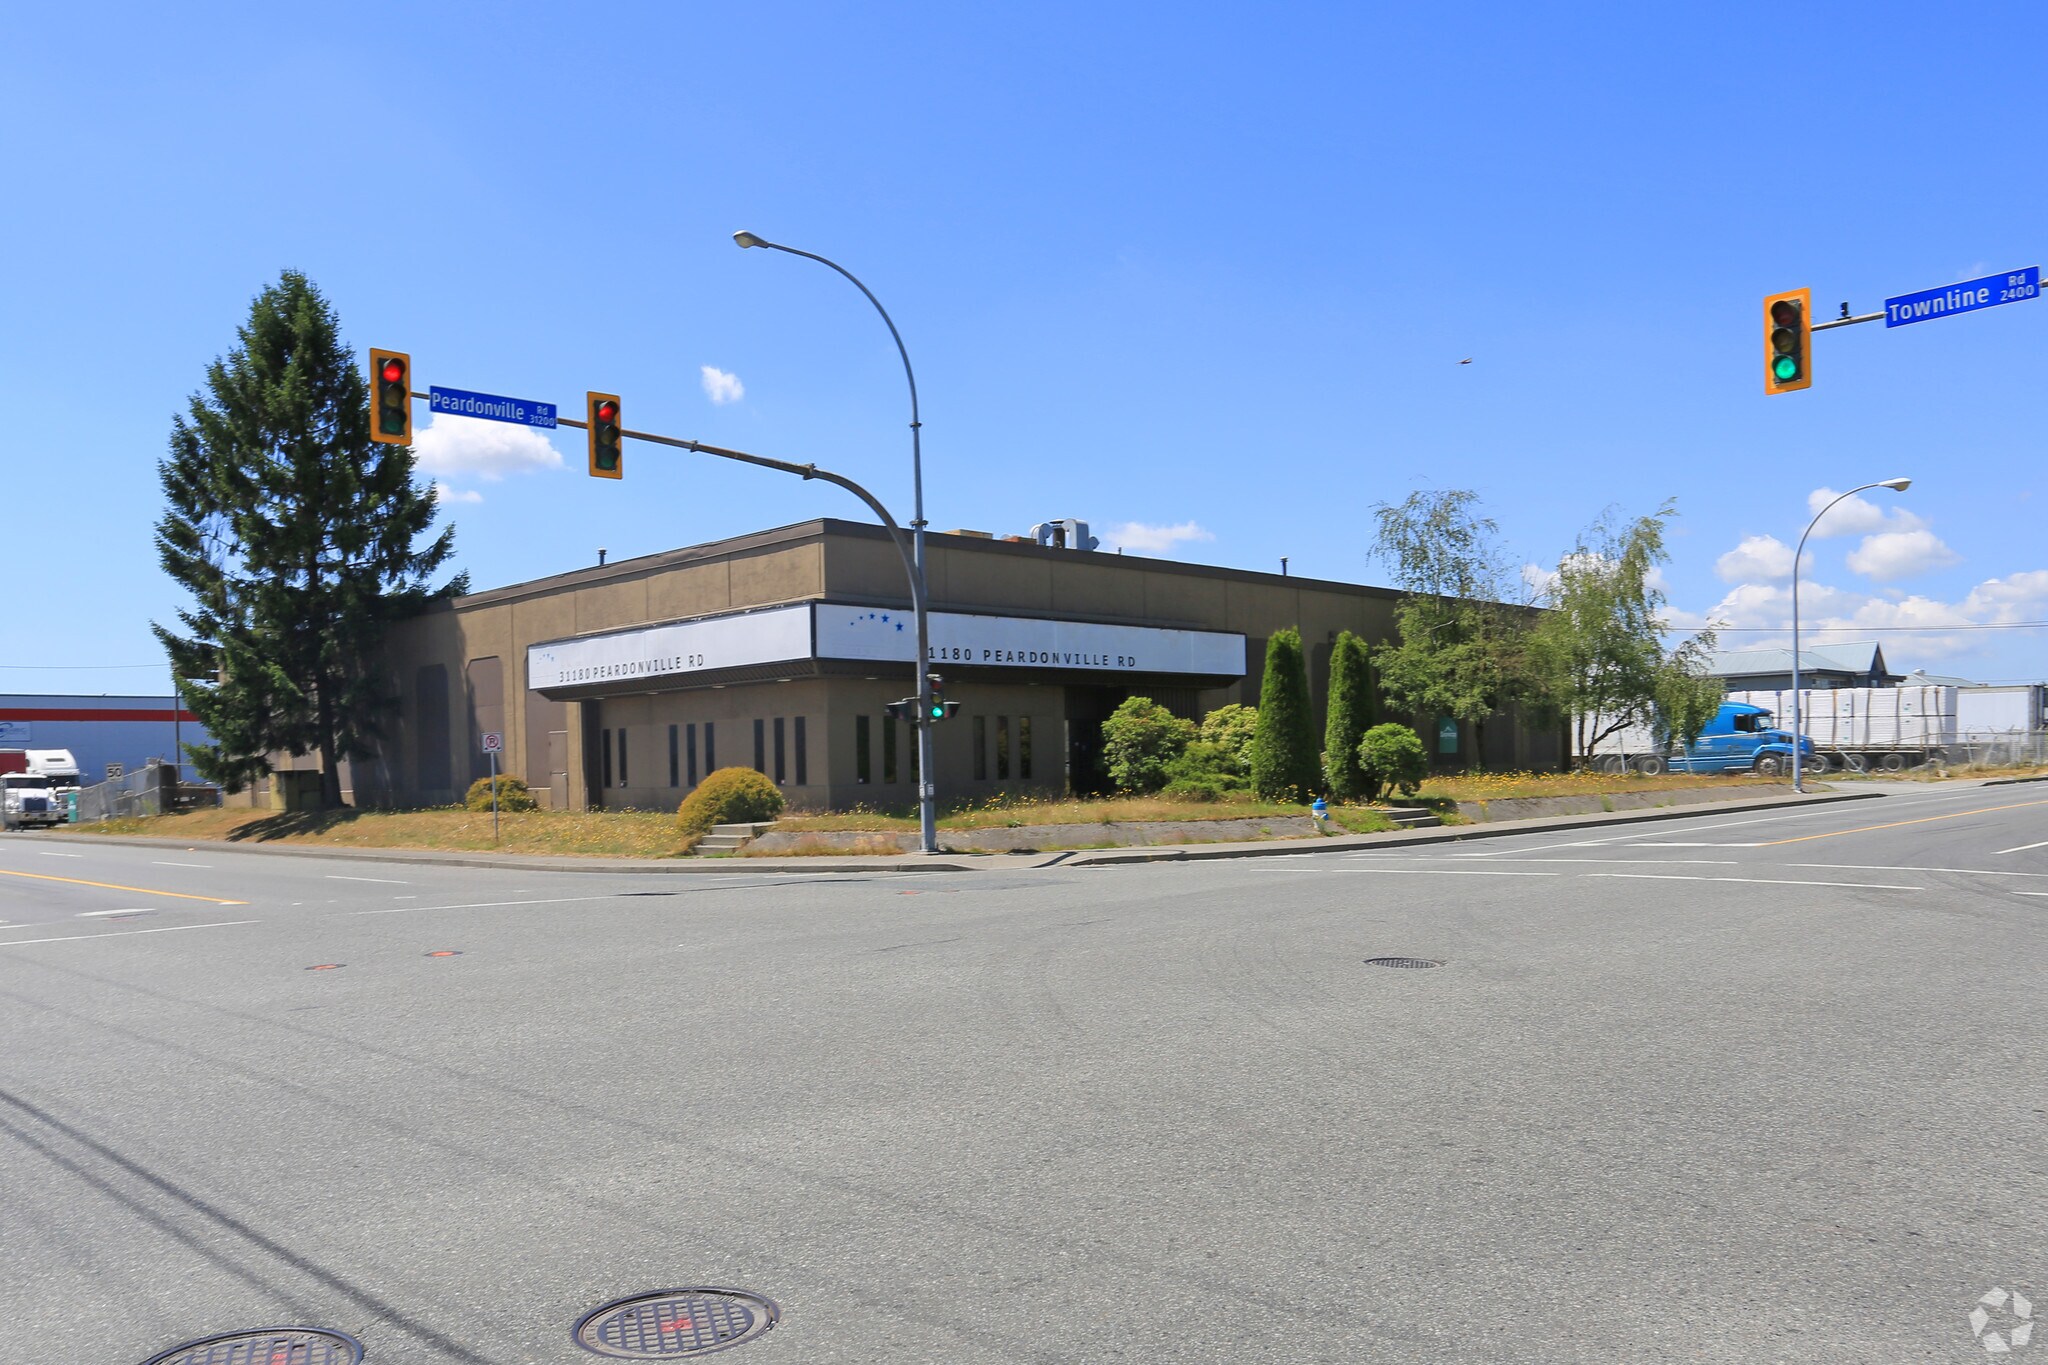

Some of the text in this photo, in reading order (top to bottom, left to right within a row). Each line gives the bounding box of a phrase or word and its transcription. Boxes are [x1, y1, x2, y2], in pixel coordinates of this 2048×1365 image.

[2007, 273, 2026, 287] Rd
[2000, 284, 2035, 301] 2400
[1889, 287, 1990, 322] Townline
[432, 392, 525, 421] Peardonville
[536, 405, 549, 416] Rd
[529, 414, 555, 427] 31200
[928, 646, 1137, 668] 1180 PEARDONVILLE RD
[559, 653, 705, 683] 31180 PEARDONVILLE RD
[107, 767, 122, 778] 50
